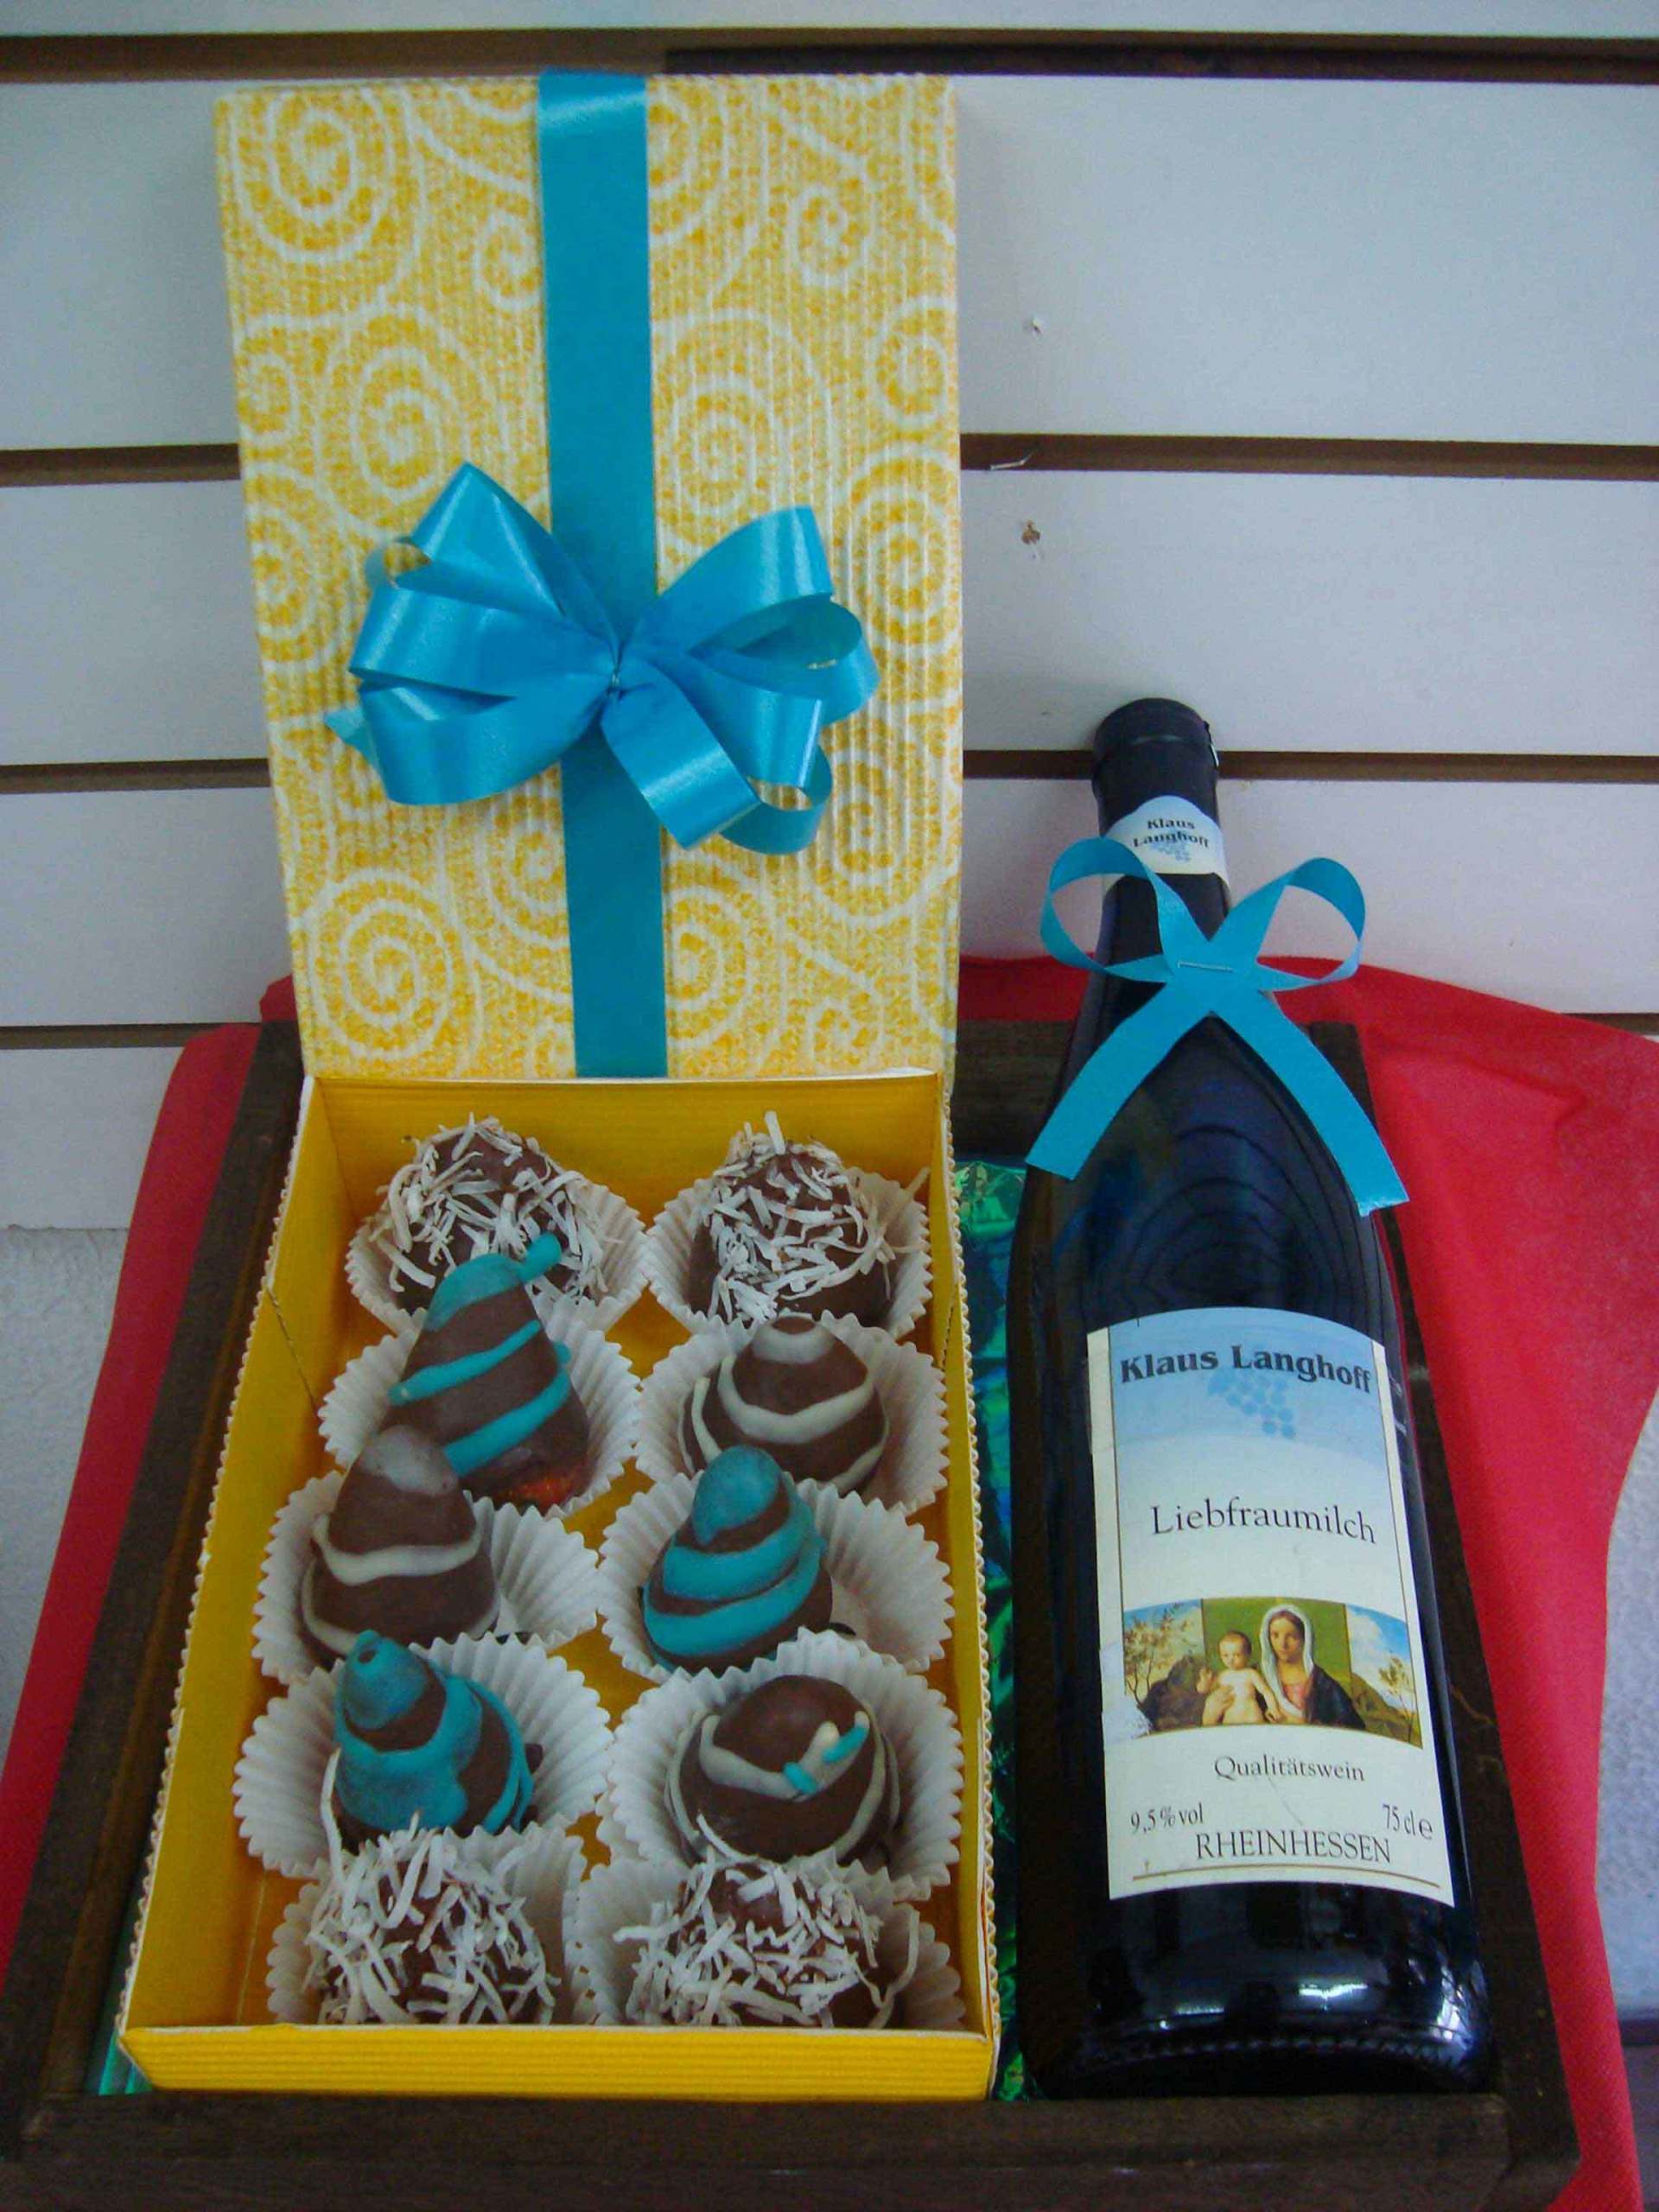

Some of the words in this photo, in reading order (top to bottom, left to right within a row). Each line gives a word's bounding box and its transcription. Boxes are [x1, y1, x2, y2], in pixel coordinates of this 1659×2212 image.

[1147, 817, 1195, 830] Klaus
[1122, 1348, 1218, 1383] Klaus
[1231, 1344, 1371, 1393] Langhoff
[1151, 1497, 1376, 1545] Liebfraumilch
[1214, 1753, 1366, 1783] Qualitätswein
[1196, 1829, 1391, 1863] RHEINHESSEN
